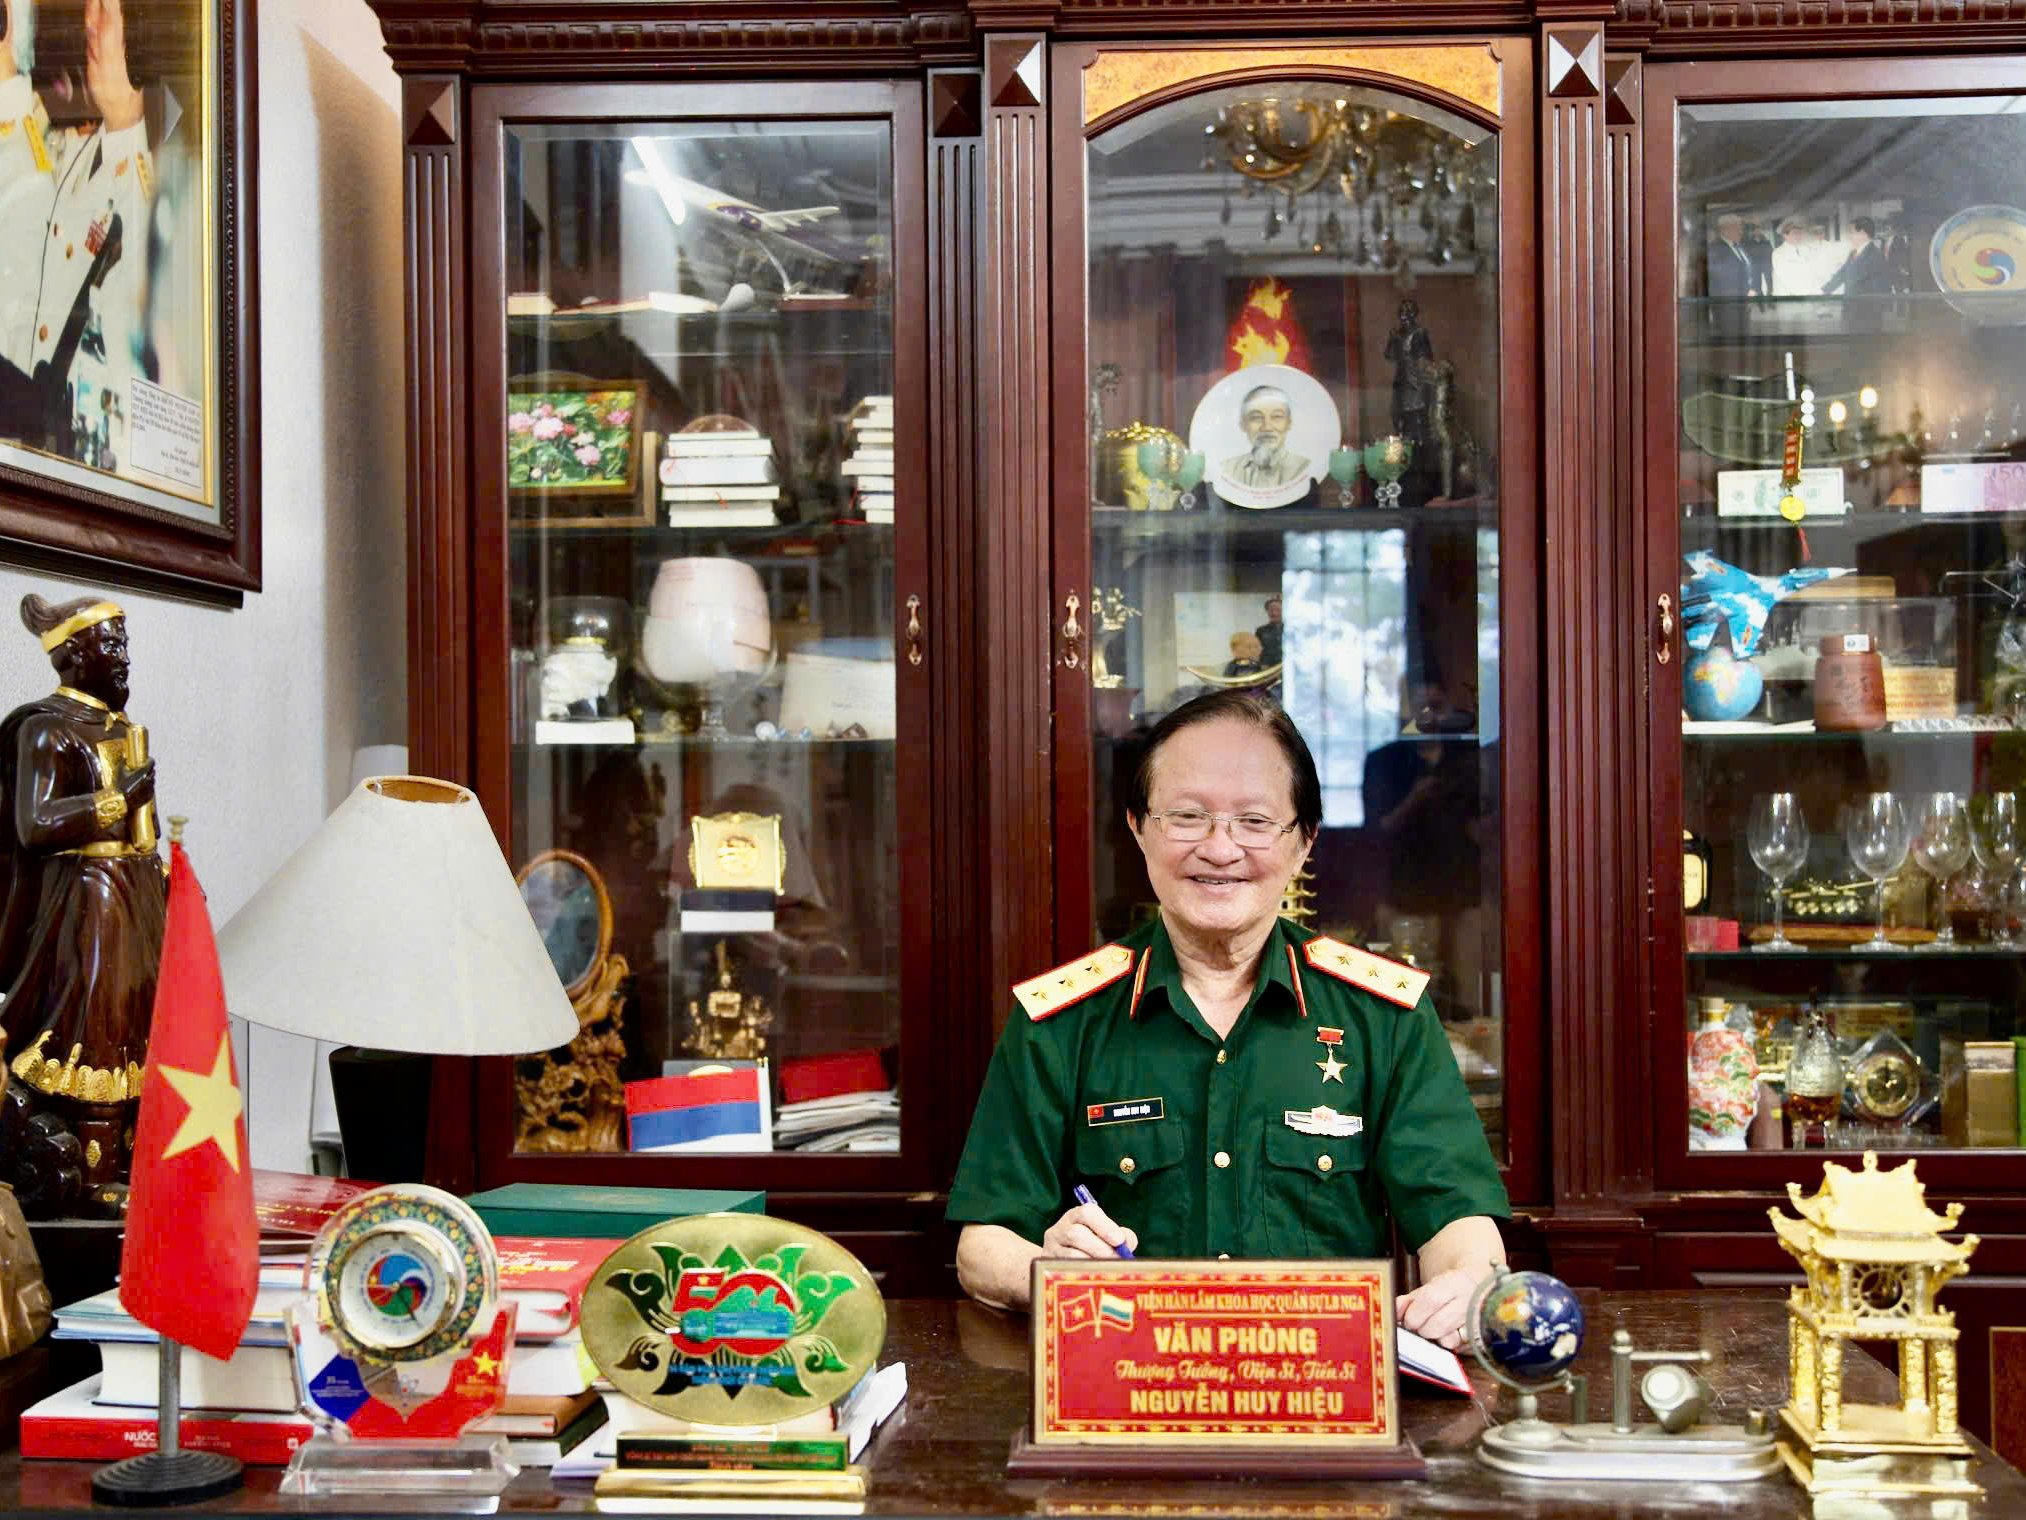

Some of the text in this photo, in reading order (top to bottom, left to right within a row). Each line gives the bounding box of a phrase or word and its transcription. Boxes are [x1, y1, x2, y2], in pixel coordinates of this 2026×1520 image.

[1217, 1293, 1250, 1310] KHOA
[1340, 1294, 1365, 1311] NGA
[1154, 1321, 1317, 1354] VĂN PHÒNG
[1129, 1383, 1344, 1419] NGUYỄN HUY HIỆU
